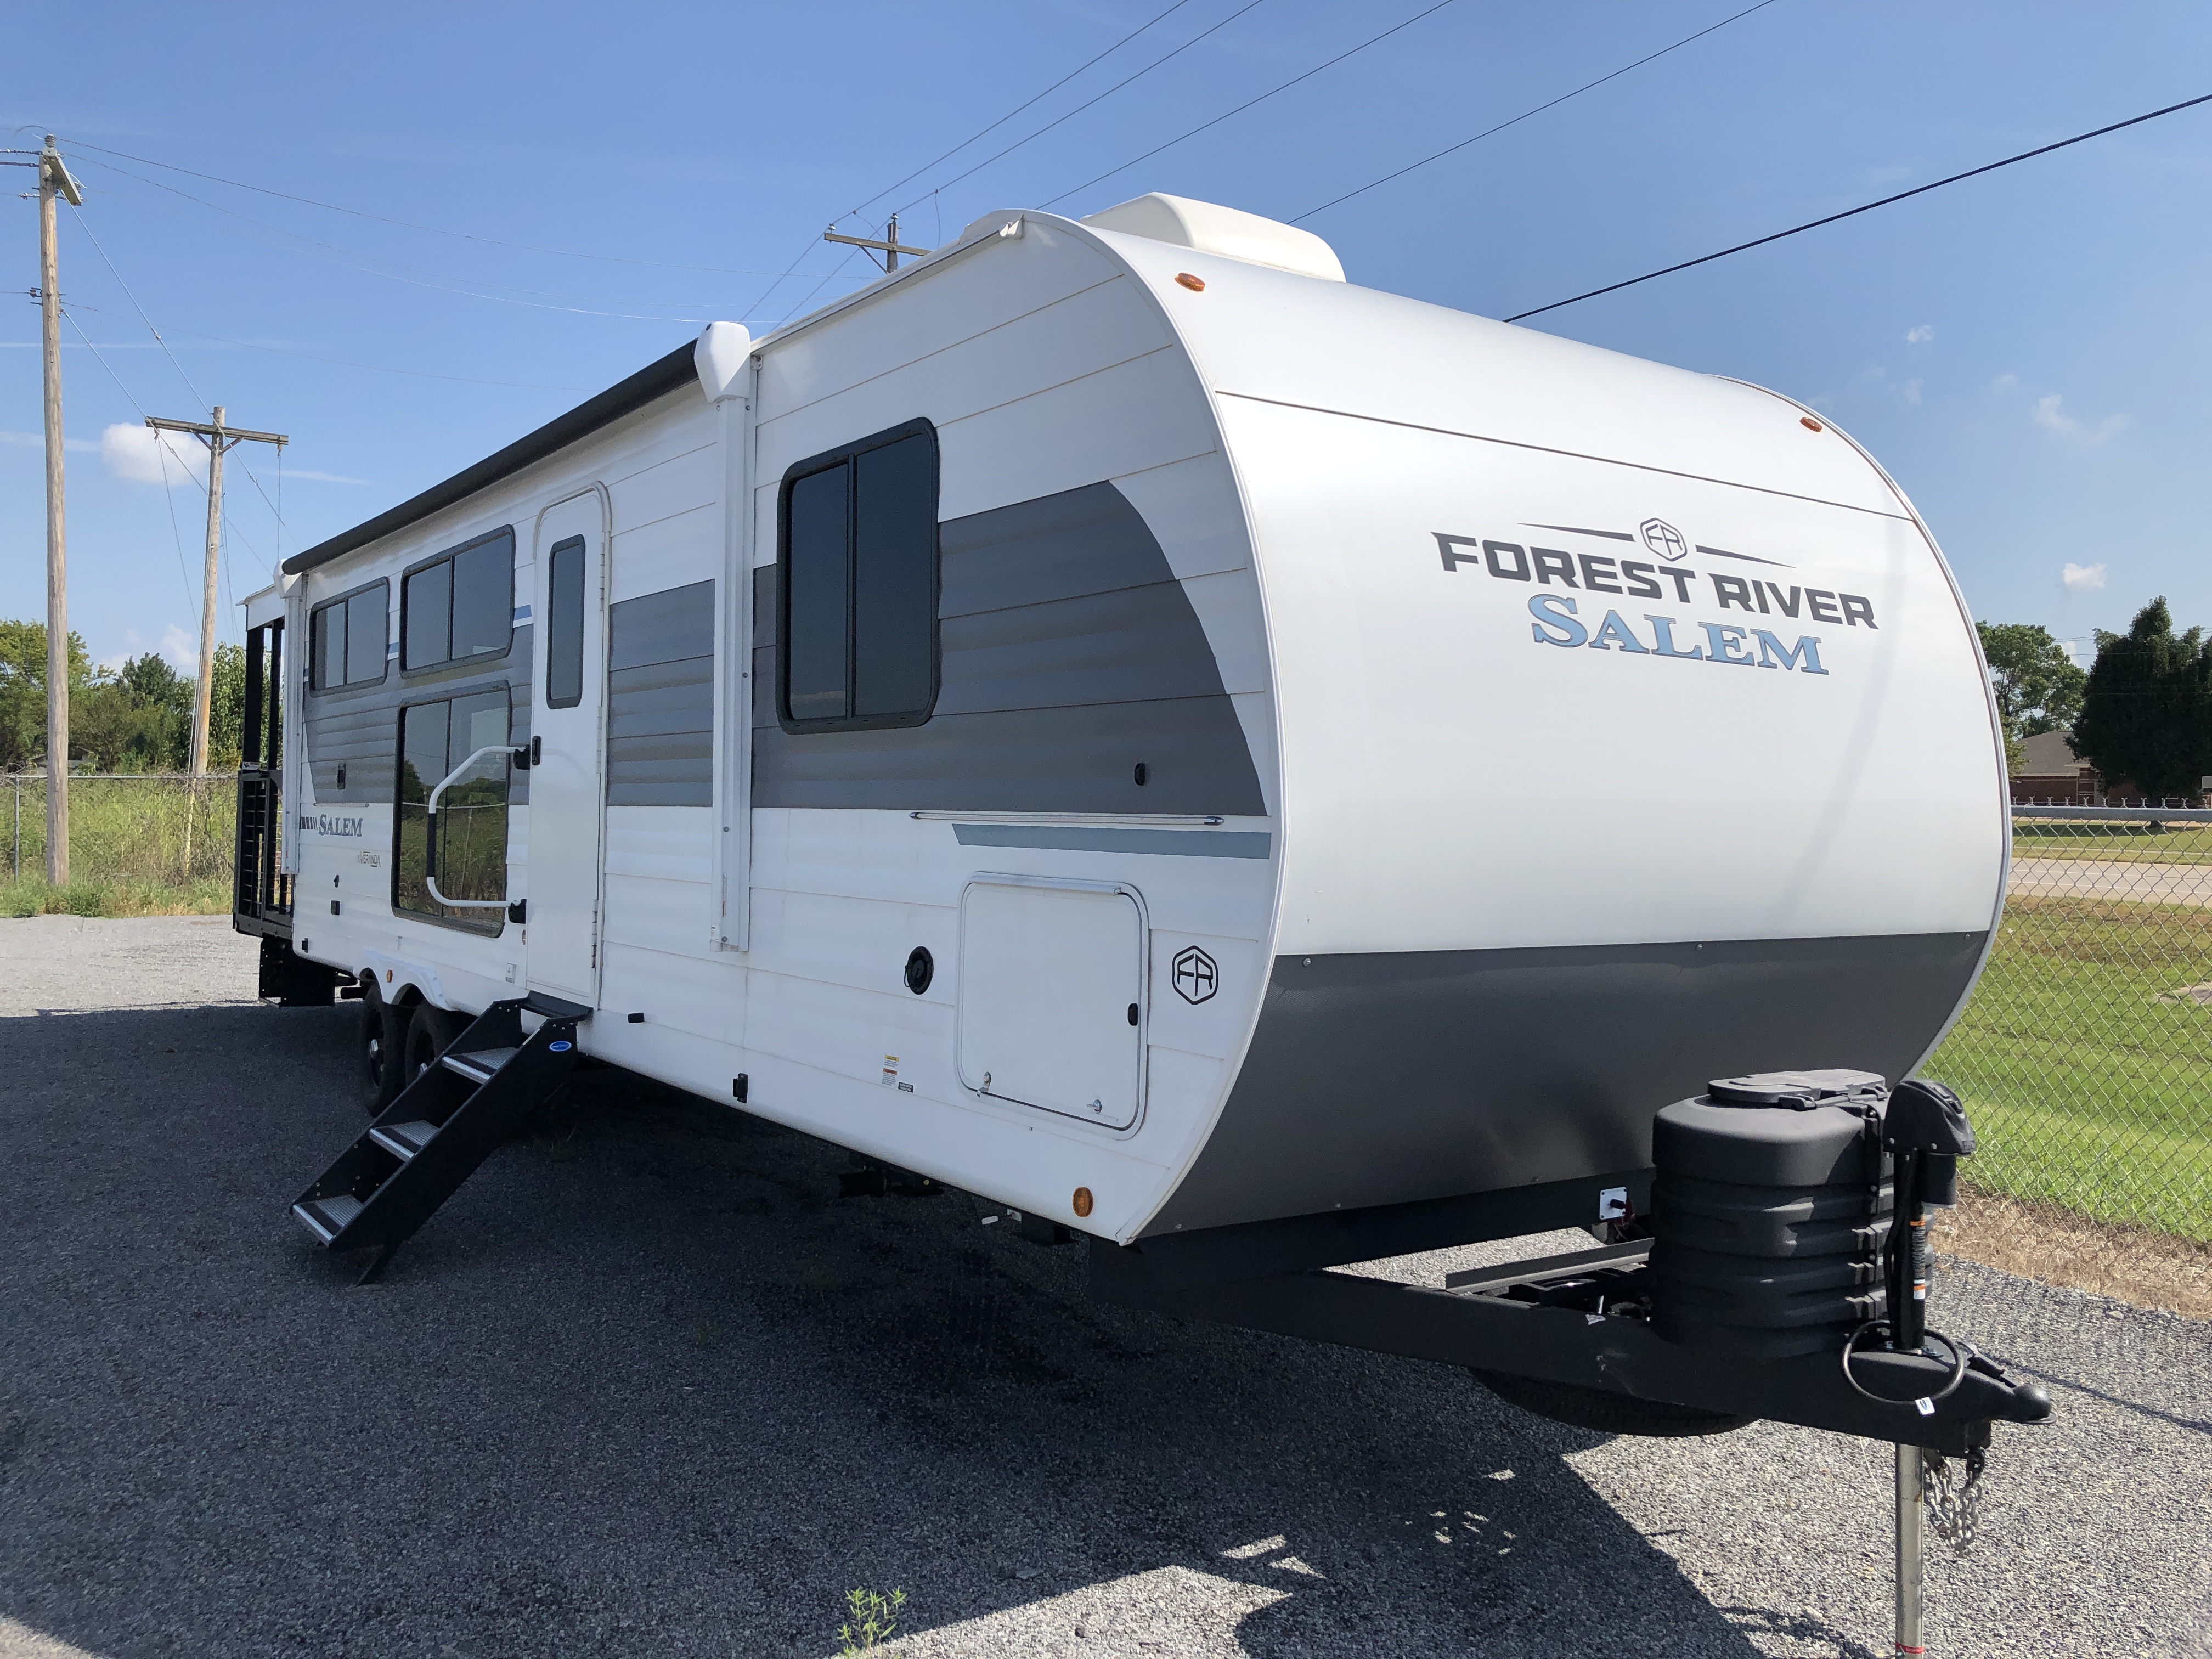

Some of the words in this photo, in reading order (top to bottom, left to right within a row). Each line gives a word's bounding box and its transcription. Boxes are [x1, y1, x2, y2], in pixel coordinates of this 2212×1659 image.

[1645, 523, 1683, 555] FR
[1430, 531, 1696, 603] FOREST
[1707, 573, 1880, 630] RIVER
[1527, 594, 1830, 676] SALEM
[318, 814, 363, 837] SALEM
[1177, 952, 1214, 997] FR
